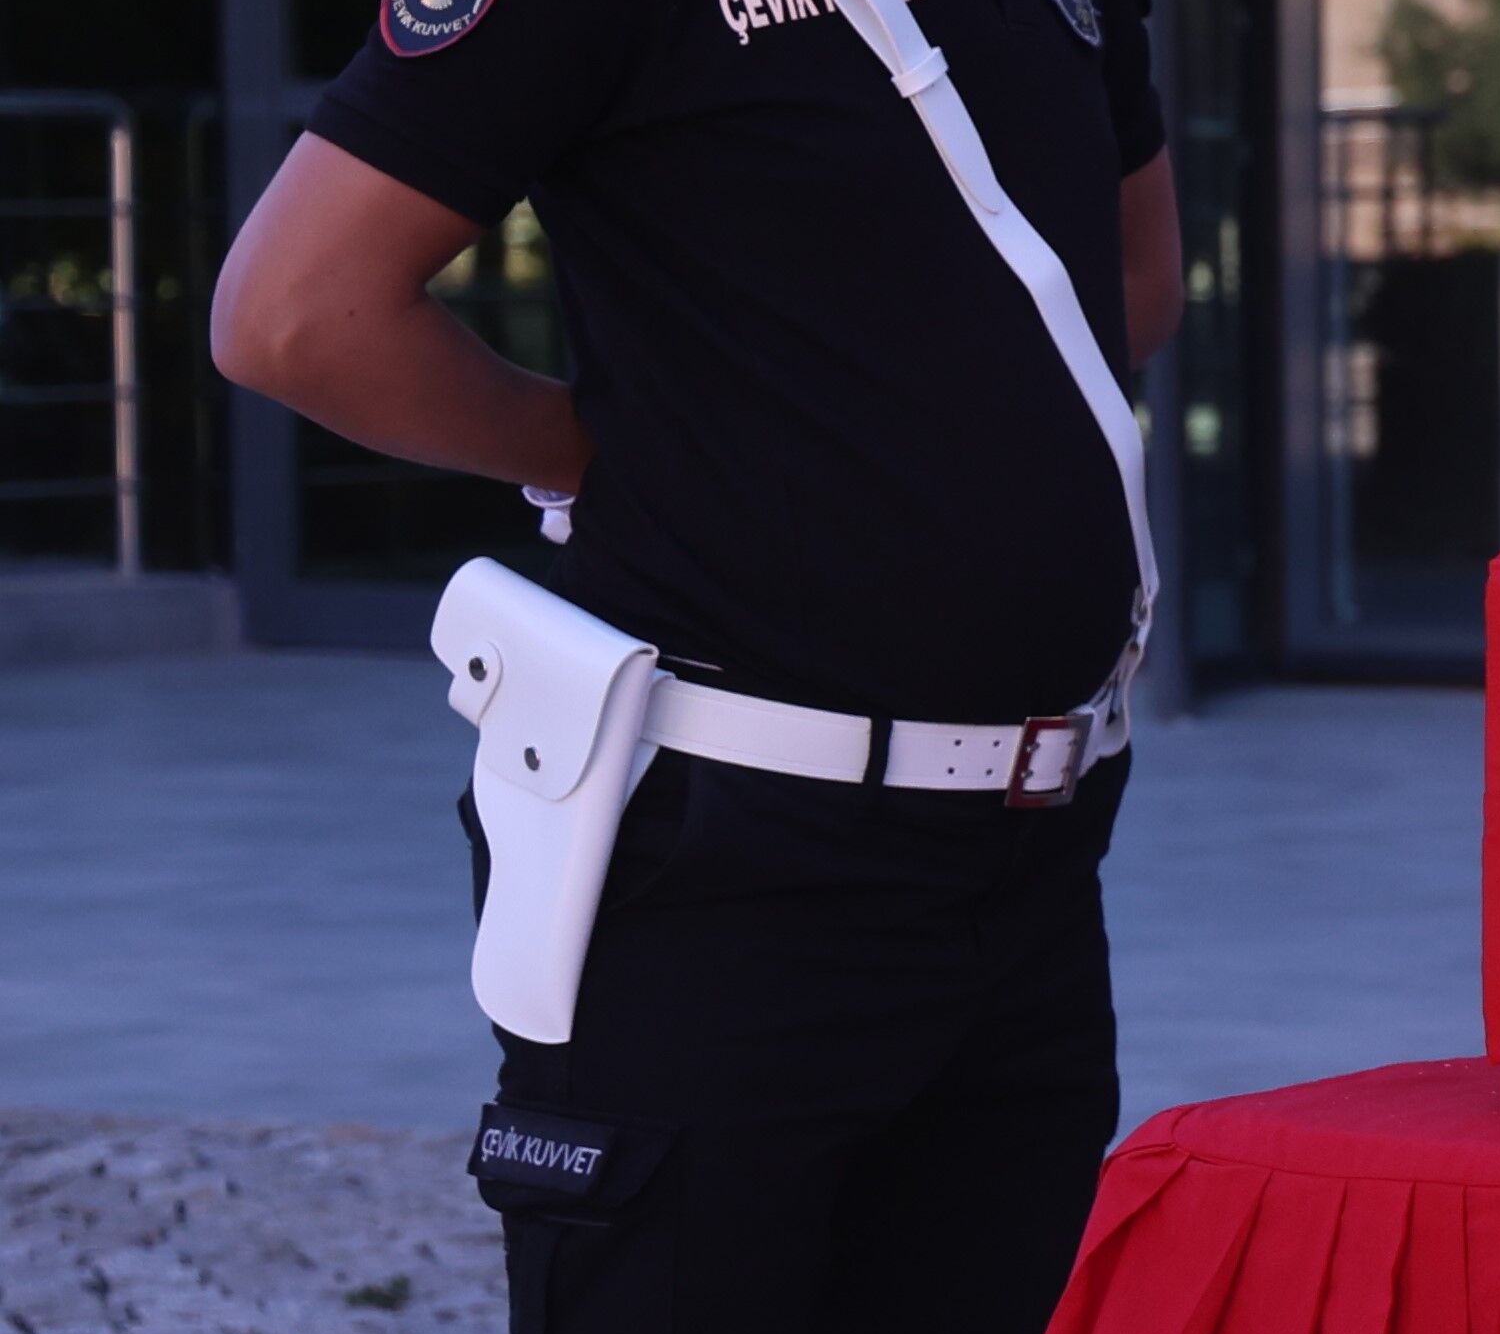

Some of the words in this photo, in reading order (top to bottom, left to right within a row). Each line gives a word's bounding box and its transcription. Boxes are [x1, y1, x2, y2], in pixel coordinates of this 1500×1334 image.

[411, 13, 471, 36] KUVVET
[481, 1125, 524, 1163] ÇEVİK
[521, 1136, 603, 1176] KUVVET
